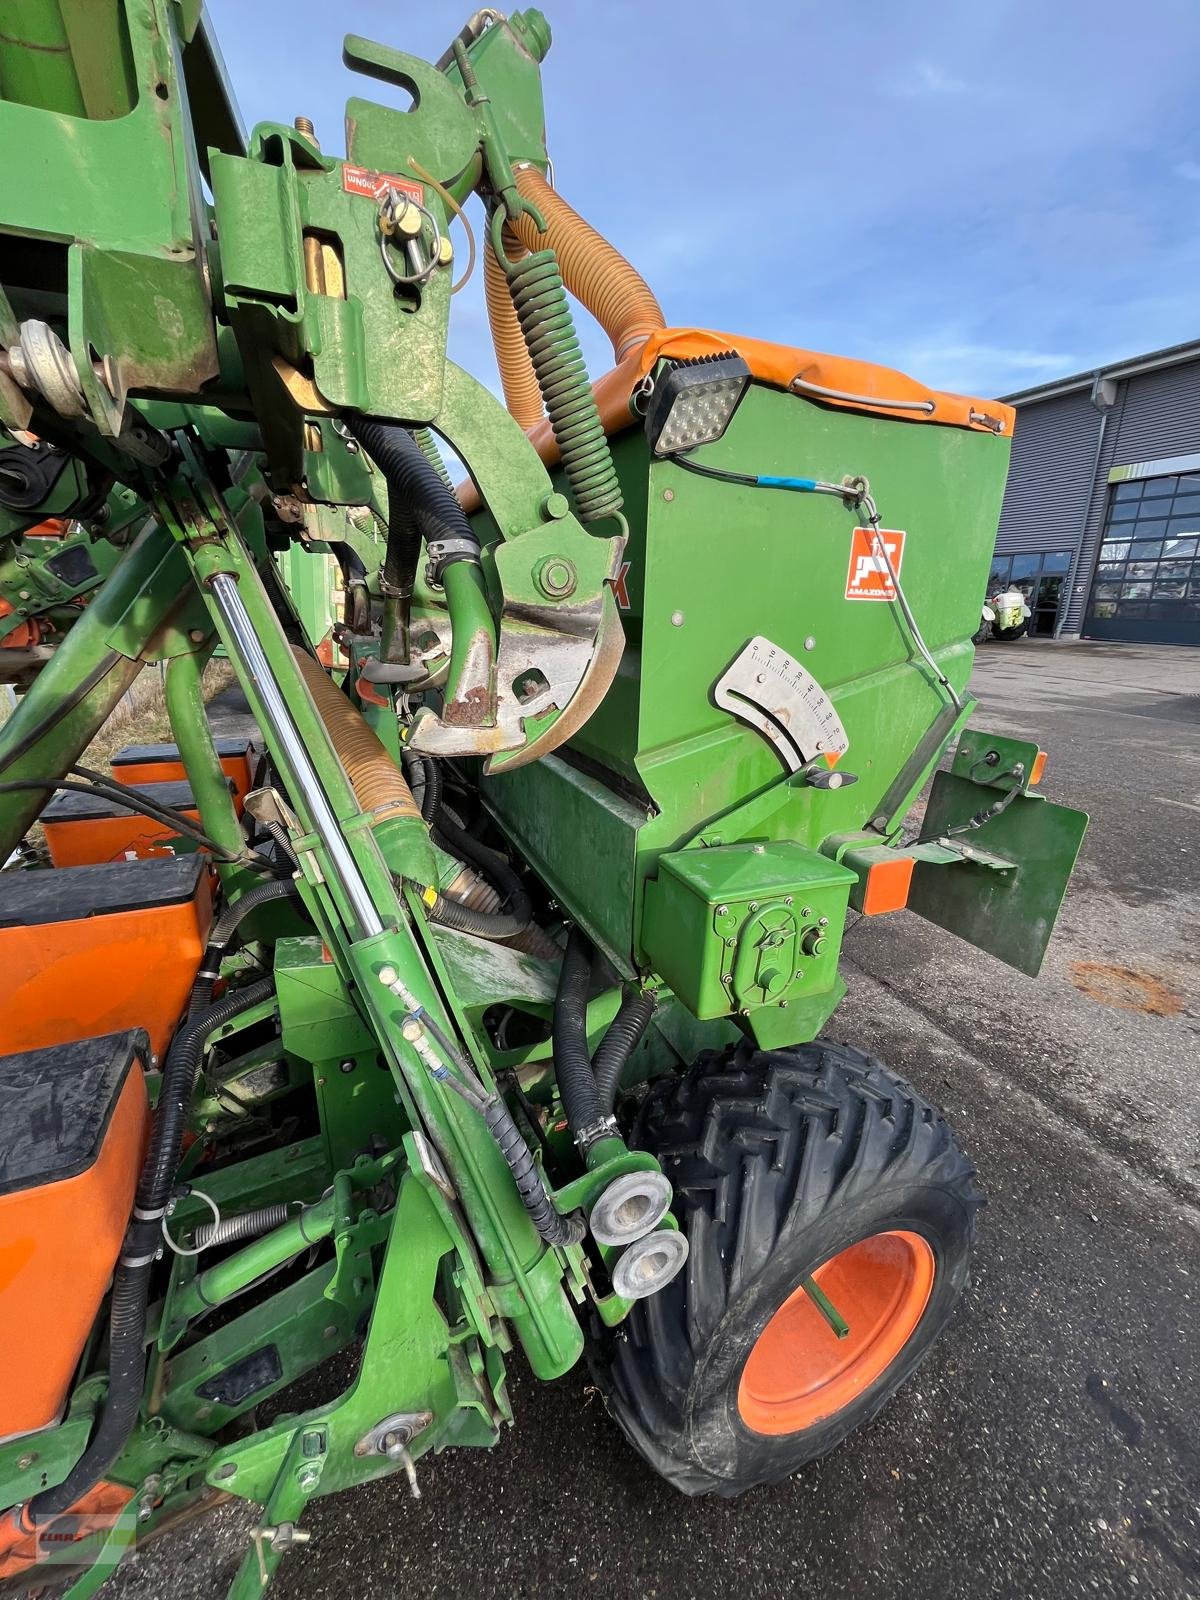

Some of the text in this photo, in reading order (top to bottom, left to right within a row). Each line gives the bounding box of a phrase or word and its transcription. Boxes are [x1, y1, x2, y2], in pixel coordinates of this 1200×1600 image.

[769, 650, 776, 658] 10
[783, 660, 790, 669] 20
[795, 671, 803, 680] 30
[807, 684, 814, 693] 40
[817, 697, 824, 706] 50
[825, 712, 833, 720] 60
